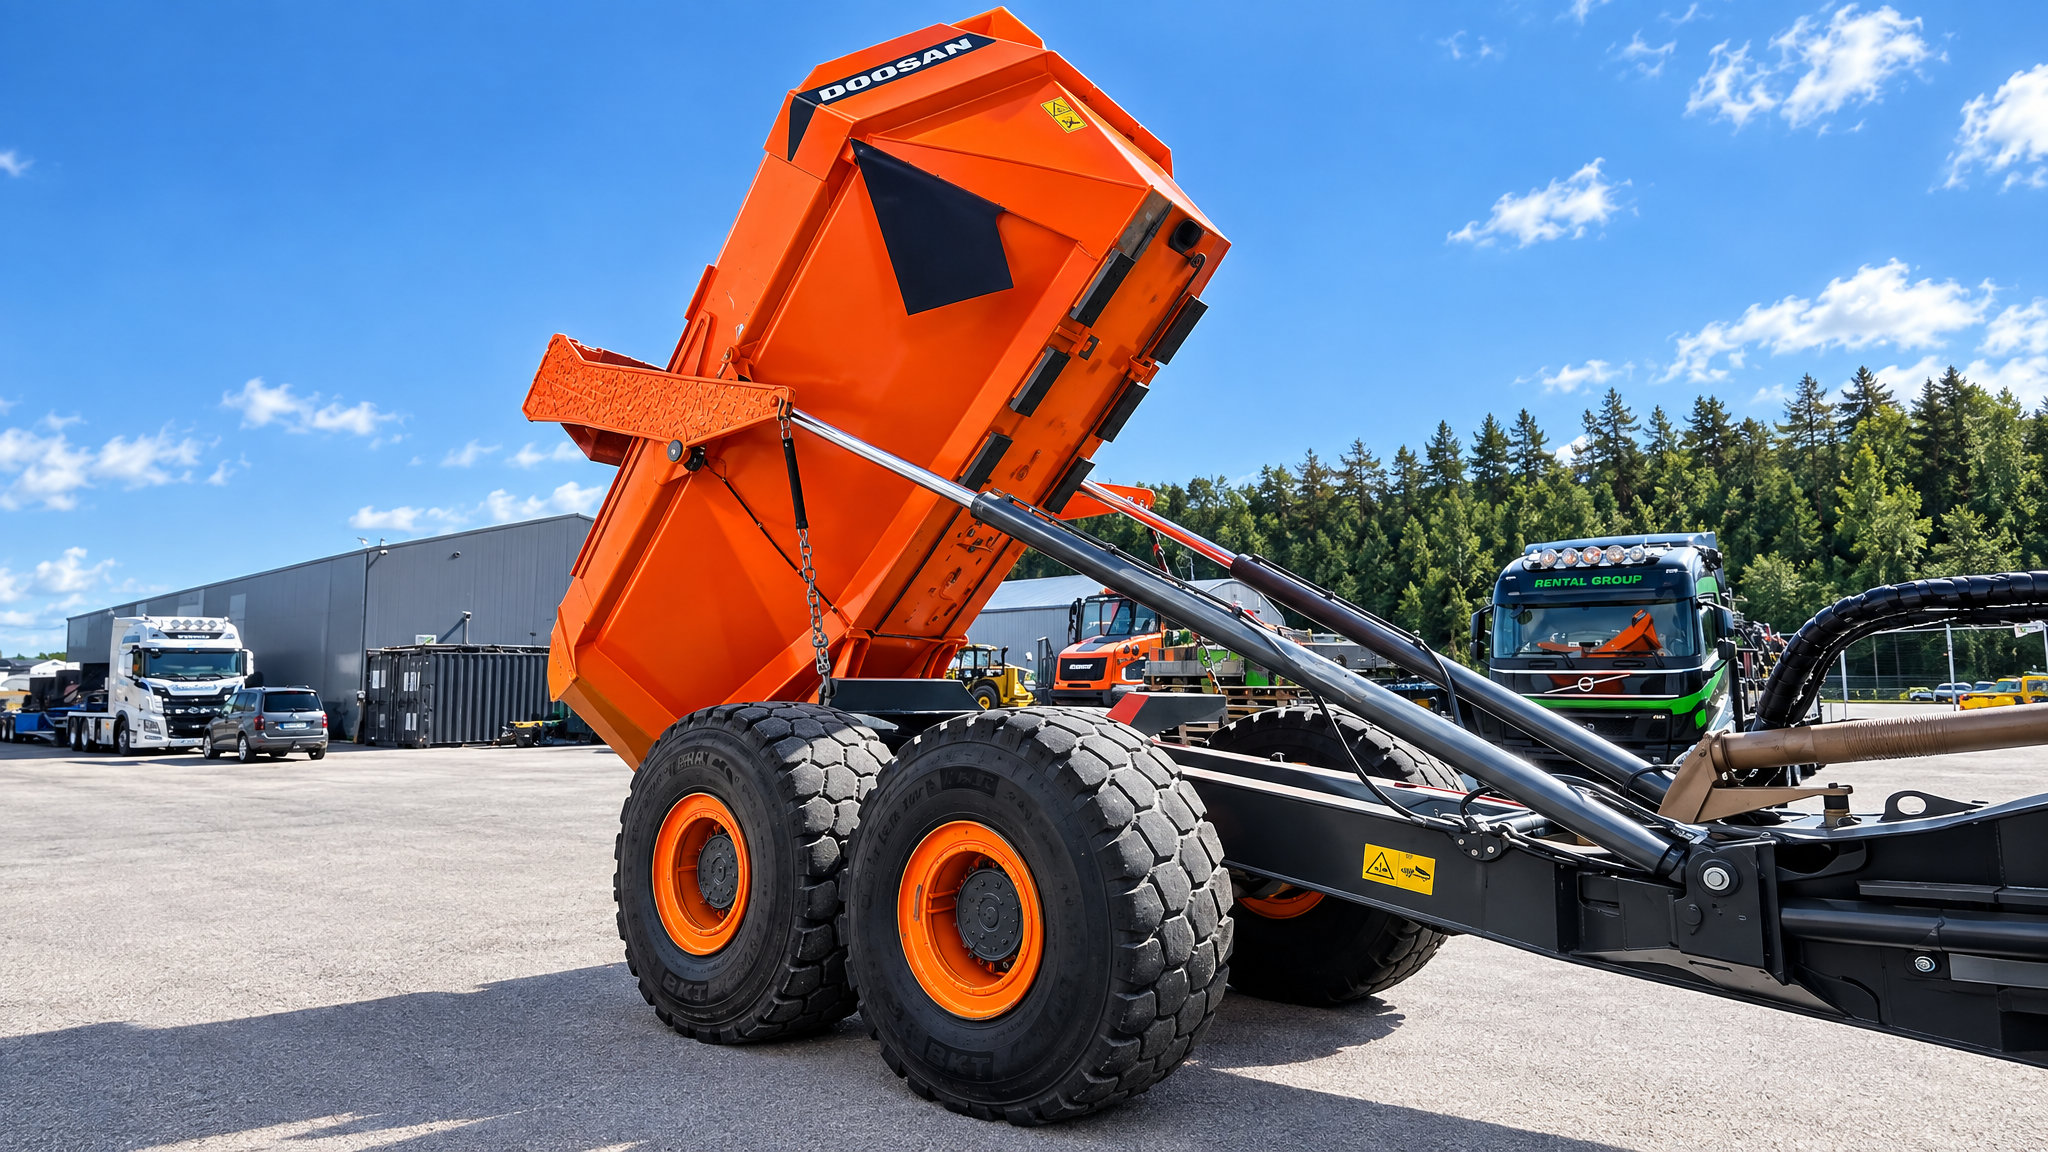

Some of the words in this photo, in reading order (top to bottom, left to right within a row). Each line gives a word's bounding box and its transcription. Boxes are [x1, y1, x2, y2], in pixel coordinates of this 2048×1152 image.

[818, 37, 973, 102] DOOSAN
[1534, 577, 1588, 588] RENTAL
[1591, 575, 1643, 586] GROUP
[925, 1042, 990, 1079] BKT
